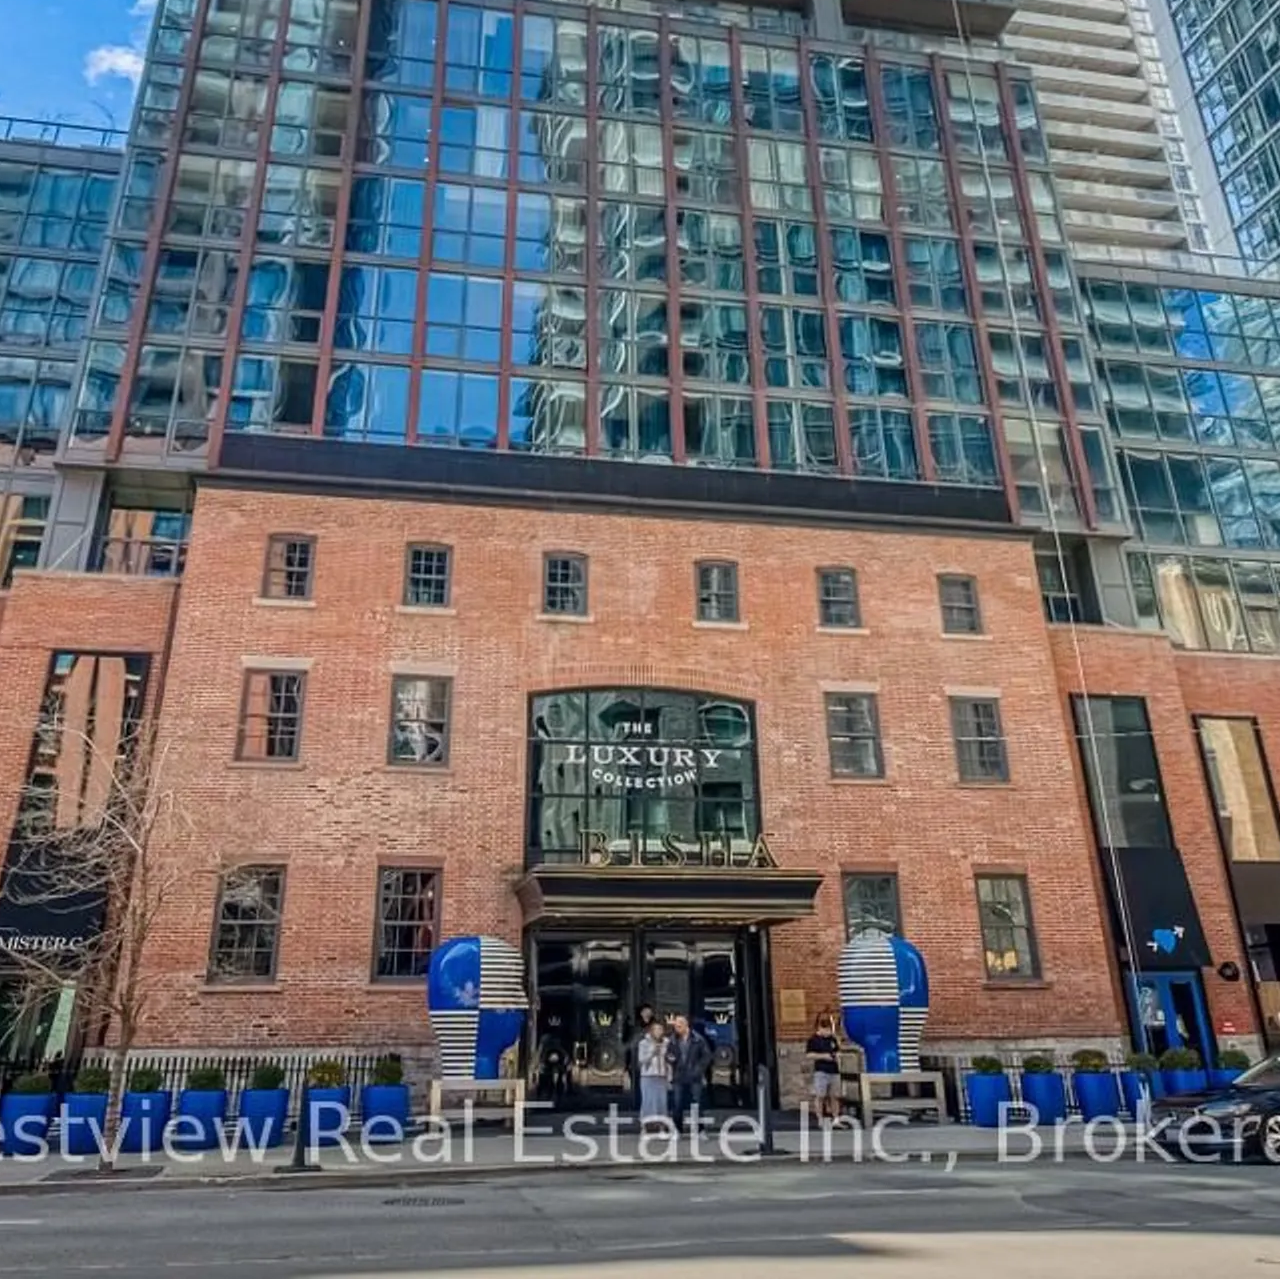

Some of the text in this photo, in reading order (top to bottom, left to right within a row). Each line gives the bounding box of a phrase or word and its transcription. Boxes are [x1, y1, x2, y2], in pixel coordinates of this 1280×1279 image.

[622, 722, 652, 734] THE
[566, 745, 723, 768] LUXURY
[579, 829, 780, 868] BISHA
